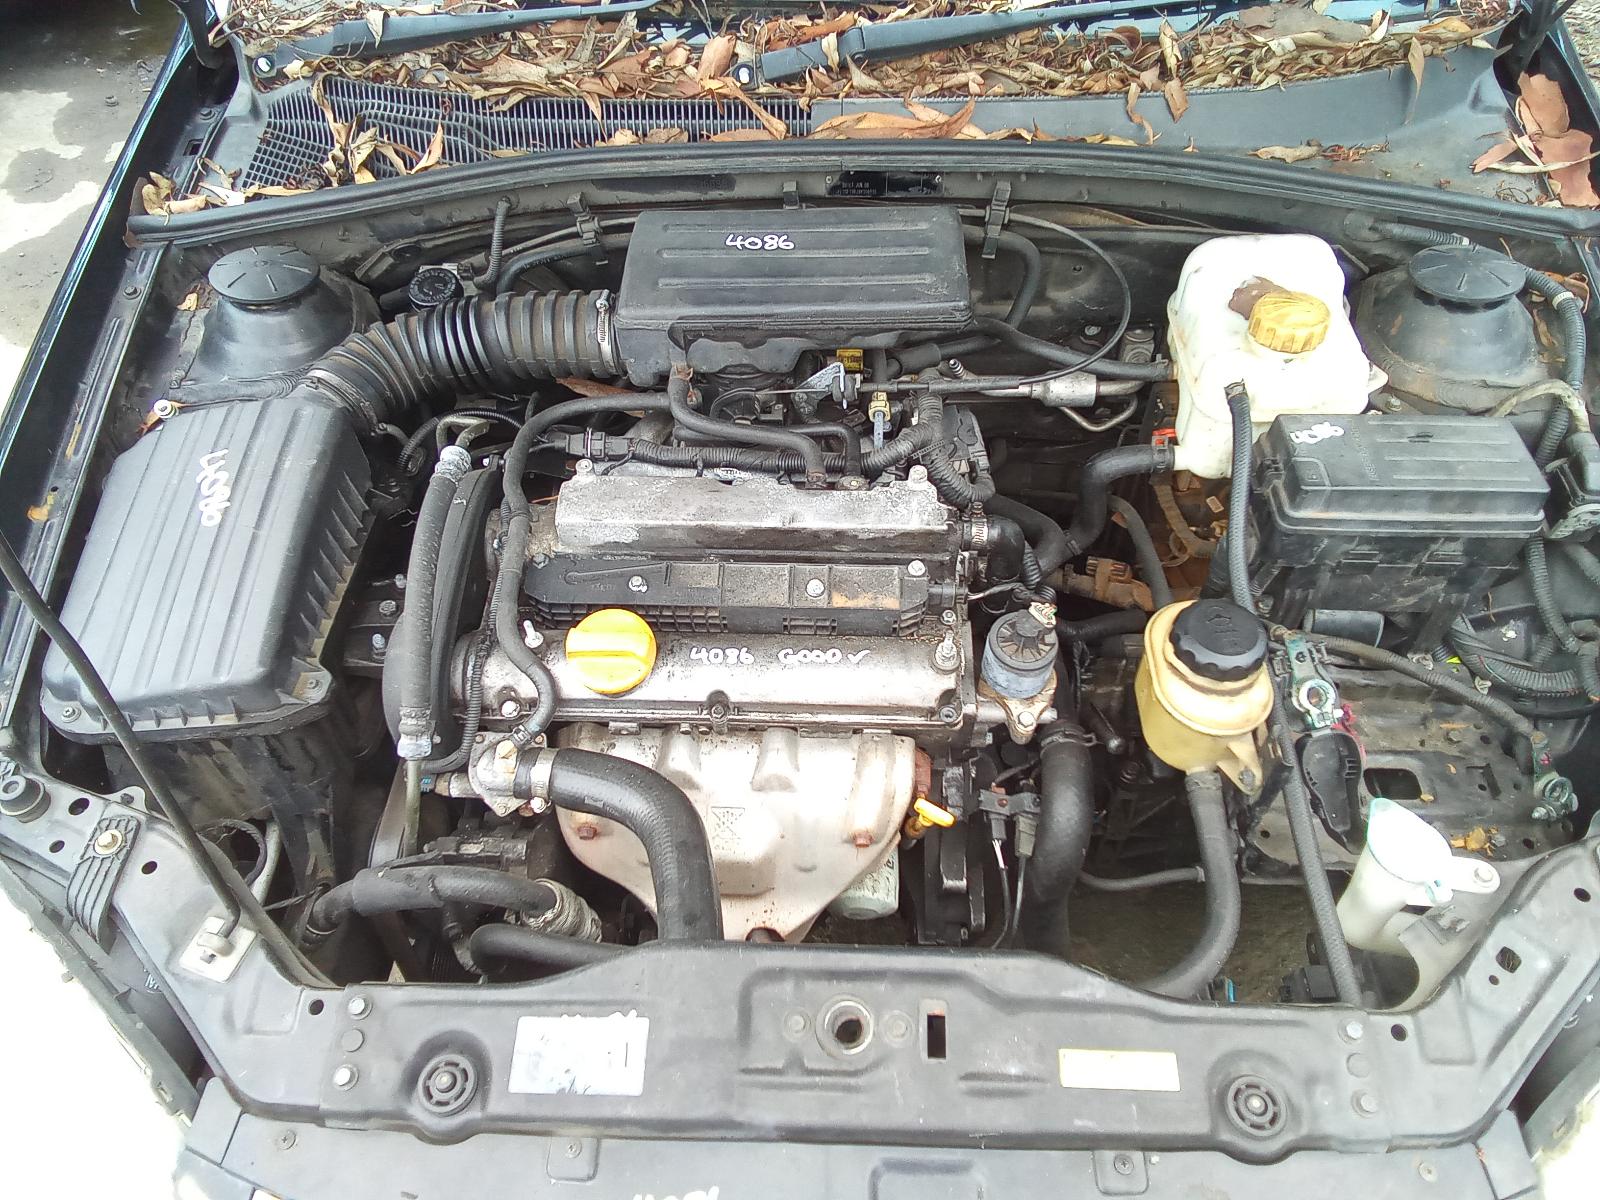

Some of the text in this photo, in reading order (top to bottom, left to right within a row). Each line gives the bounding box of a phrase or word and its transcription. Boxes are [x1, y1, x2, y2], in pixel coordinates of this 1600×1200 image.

[725, 233, 795, 250] 4086
[689, 647, 843, 665] 4086 GOOD
